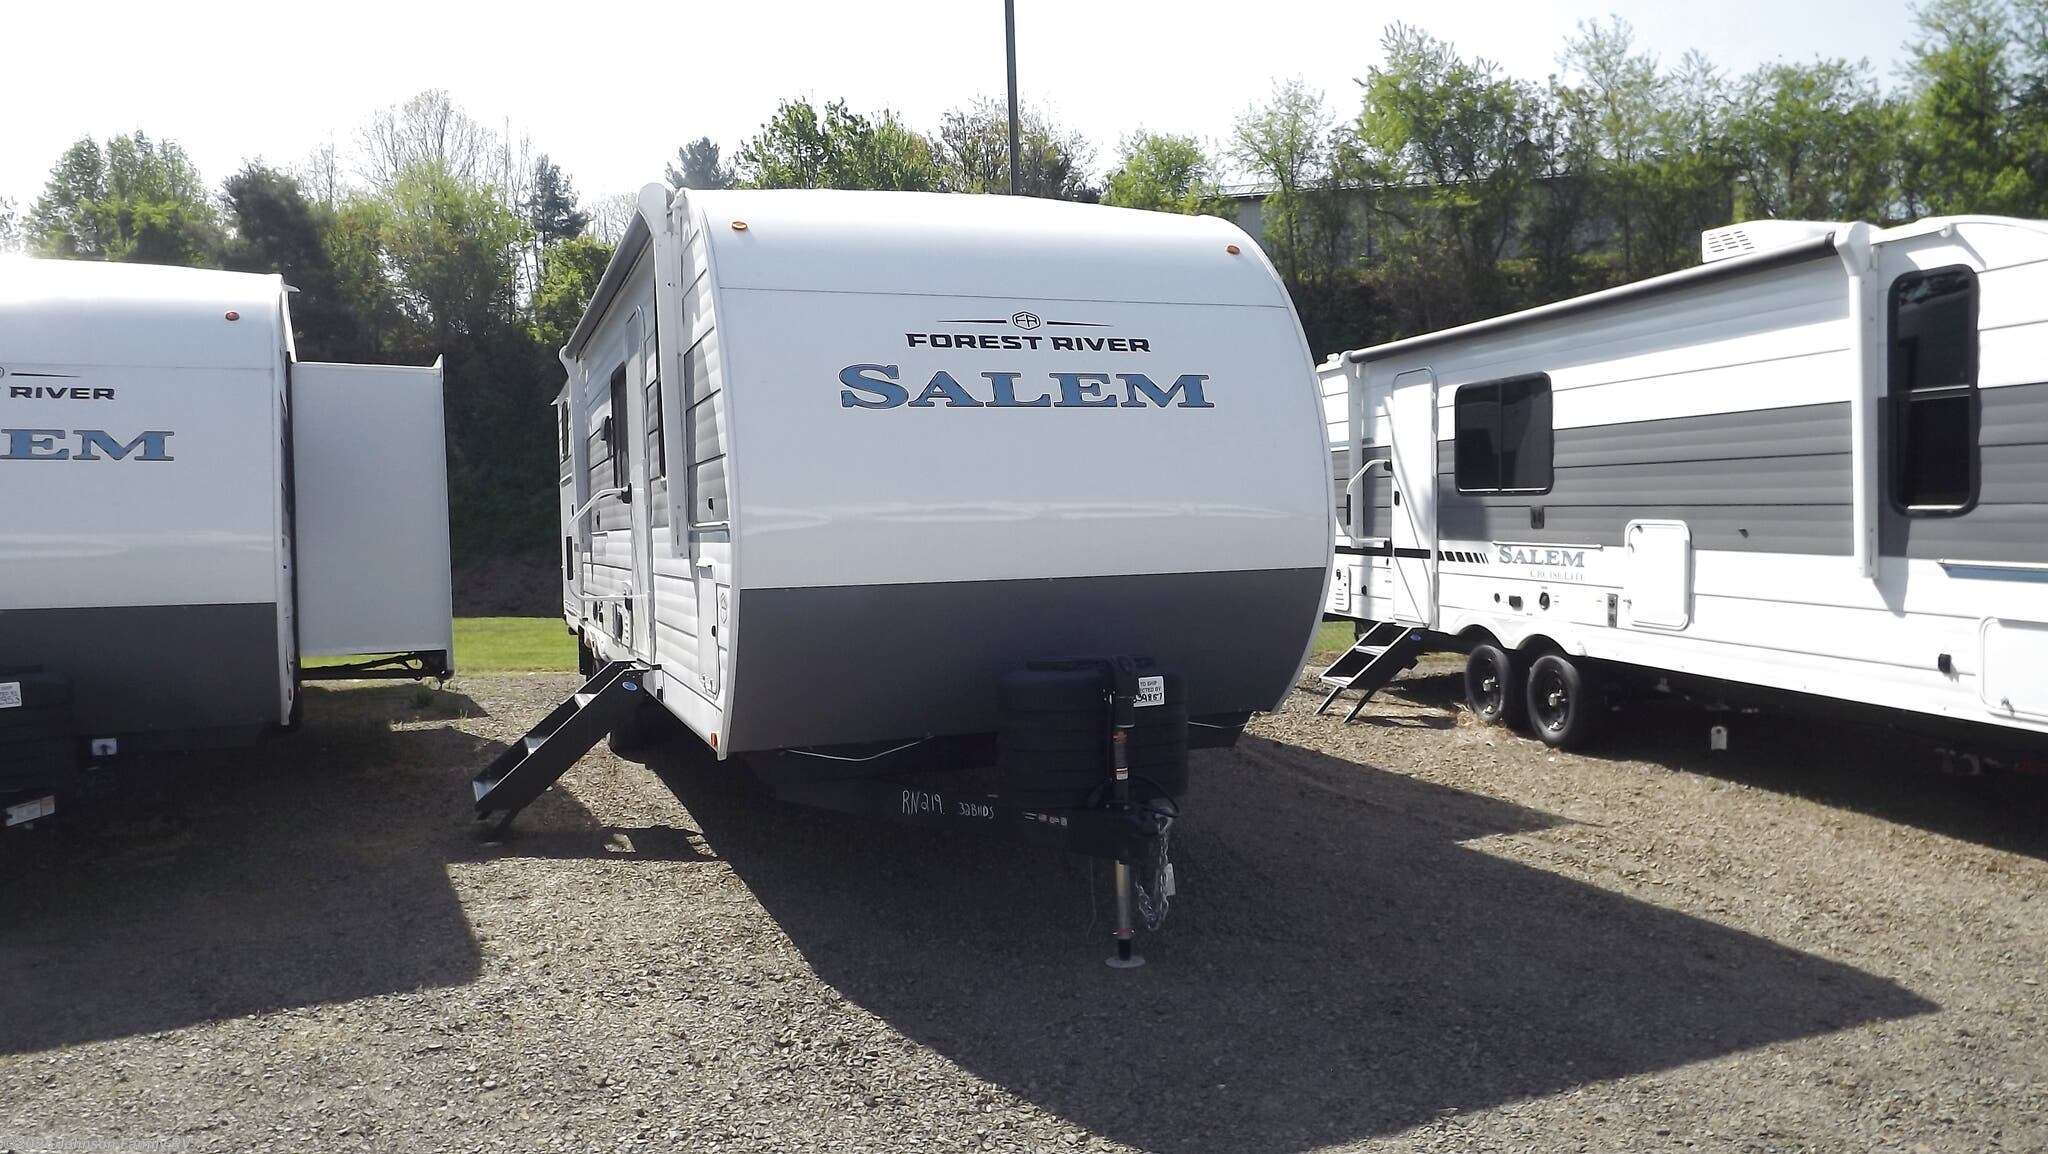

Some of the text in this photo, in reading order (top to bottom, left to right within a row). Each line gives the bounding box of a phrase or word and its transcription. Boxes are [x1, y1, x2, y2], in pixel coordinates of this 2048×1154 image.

[905, 333, 1151, 352] FOREST RIVER
[10, 386, 116, 400] RIVER
[839, 364, 1214, 409] SALEM
[1499, 545, 1585, 568] SALEM
